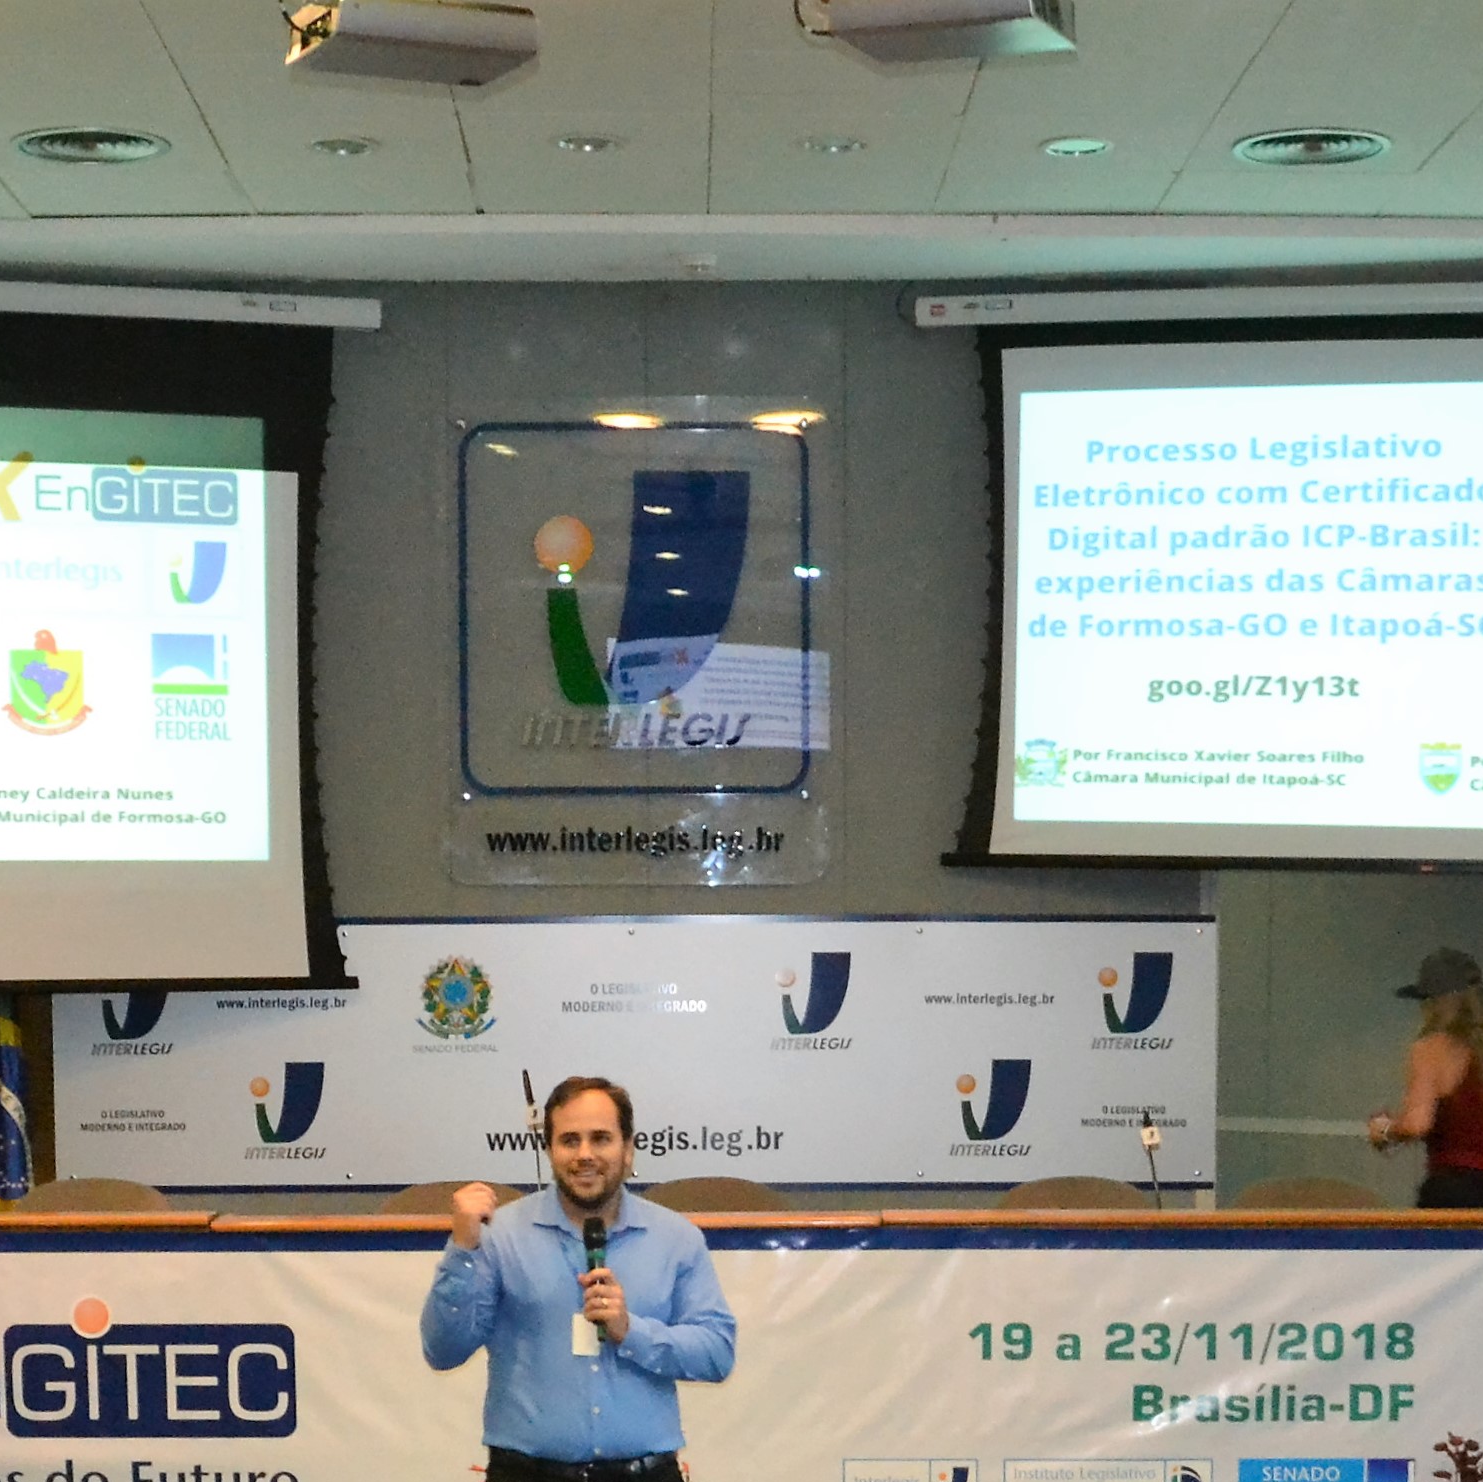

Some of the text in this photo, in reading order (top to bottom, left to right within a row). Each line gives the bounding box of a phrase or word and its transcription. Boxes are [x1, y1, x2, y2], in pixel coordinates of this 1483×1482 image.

[1087, 434, 1442, 467] Processo Legislativo
[1034, 482, 1205, 508] Eletrônico
[1217, 484, 1288, 504] com
[1048, 522, 1480, 557] Digital padrão ICP-Brasil:
[1035, 568, 1253, 600] experiências
[1266, 568, 1323, 592] das
[1028, 614, 1066, 637] de
[1080, 613, 1288, 637] Formosa-GO
[1300, 617, 1318, 636] e
[1148, 675, 1360, 702] goo.gl/Z1y13t
[155, 698, 226, 717] SENADO
[155, 721, 231, 740] FEDERAL
[1073, 750, 1364, 763] Por Francisco Xavier Soares Filho
[1073, 772, 1346, 788] Câmara Municipal de Itapoá-SC
[36, 787, 110, 800] Caldeira
[117, 788, 174, 801] Nunes
[91, 811, 112, 823] de
[118, 812, 227, 824] Formosa-GO
[487, 826, 784, 856] www.interlegis.leg.br
[590, 984, 599, 994] O
[217, 998, 346, 1010] www.interlegis.leg.br
[562, 1001, 623, 1012] MODERNO
[924, 993, 1054, 1007] www.interlegis.leg.br
[91, 1043, 173, 1055] INTERLEGIS
[770, 1037, 852, 1051] INTERLEGIS
[1091, 1037, 1174, 1051] INTERLEGIS
[101, 1110, 165, 1118] O LEGISLATIVO
[1102, 1106, 1108, 1114] O
[81, 1123, 126, 1131] MODERNO
[135, 1123, 185, 1131] INTEGRADO
[1081, 1119, 1126, 1127] MODERNO
[244, 1147, 326, 1160] INTERLEGIS
[949, 1144, 1031, 1157] INTERLEGIS
[969, 1320, 1416, 1366] 19 a 23/11/2018
[1132, 1381, 1416, 1424] Brasília-DF
[1012, 1467, 1072, 1482] Instituto
[1262, 1466, 1341, 1482] SENADO
